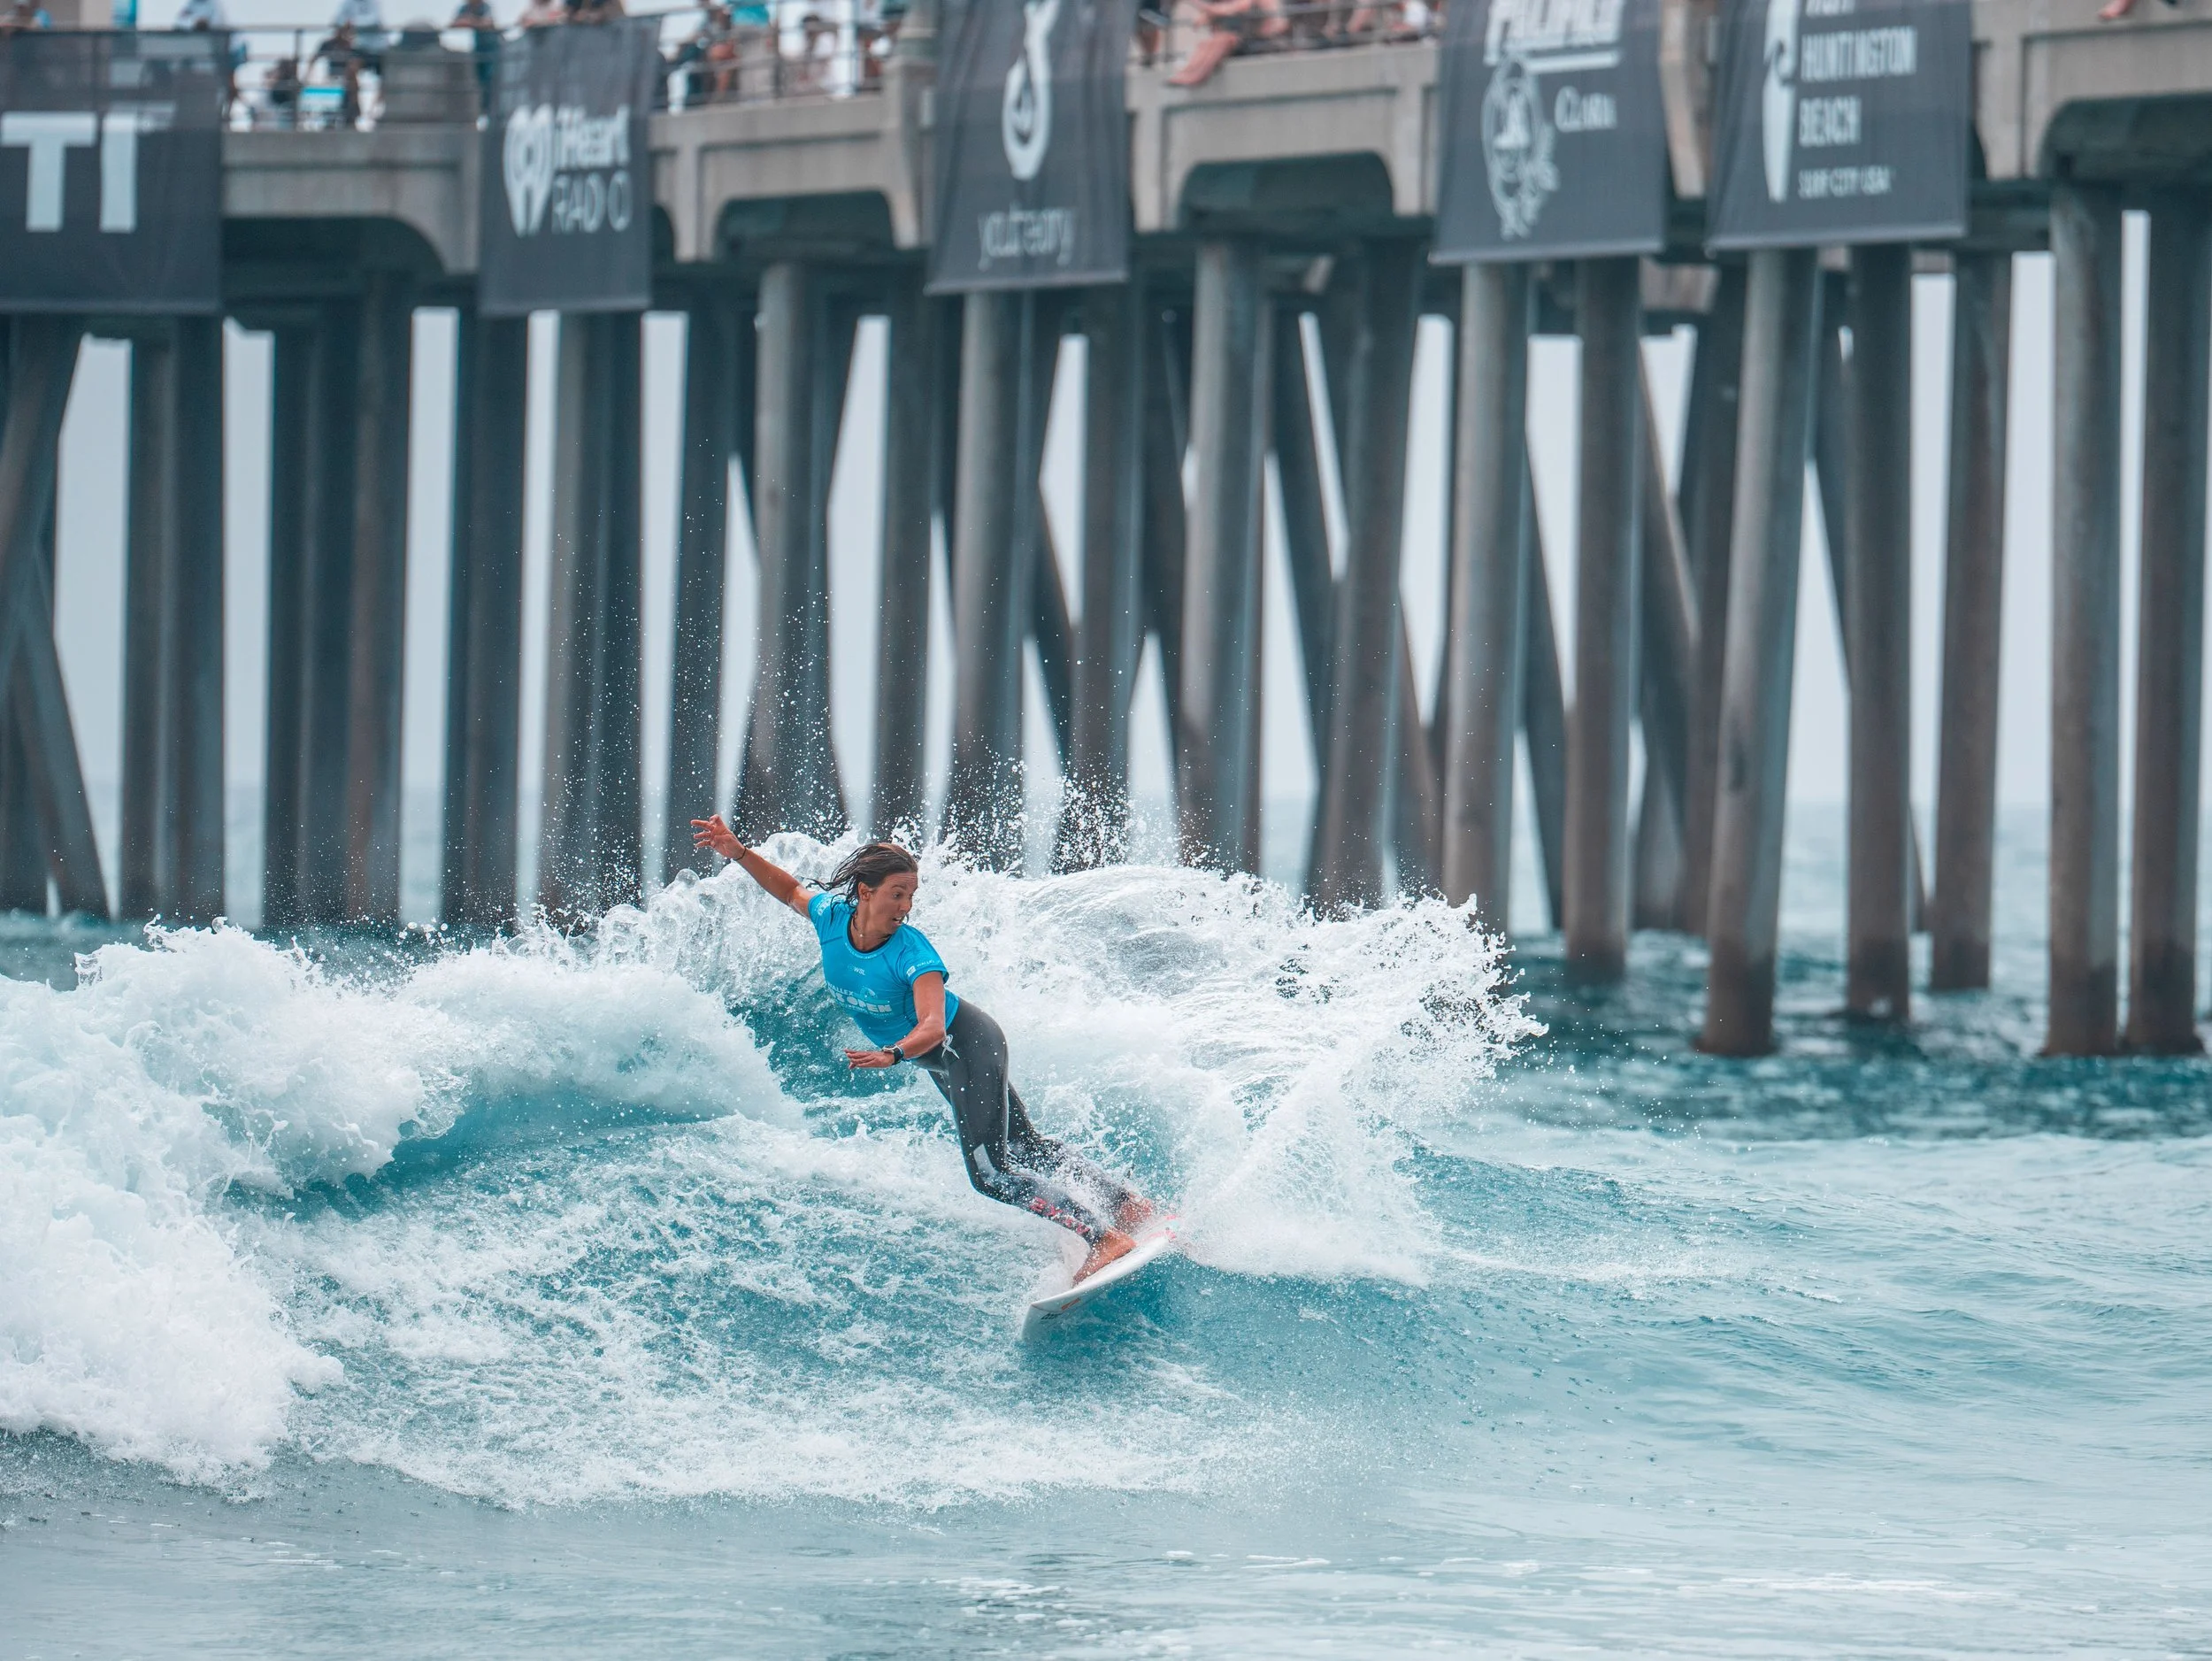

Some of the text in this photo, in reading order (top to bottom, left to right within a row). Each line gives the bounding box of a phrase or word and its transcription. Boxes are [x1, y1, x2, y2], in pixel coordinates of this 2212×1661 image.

[1800, 25, 1916, 81] HUNTINGTON
[554, 104, 631, 168] iHeart
[1798, 96, 1861, 147] BEACH
[551, 172, 634, 234] RADO
